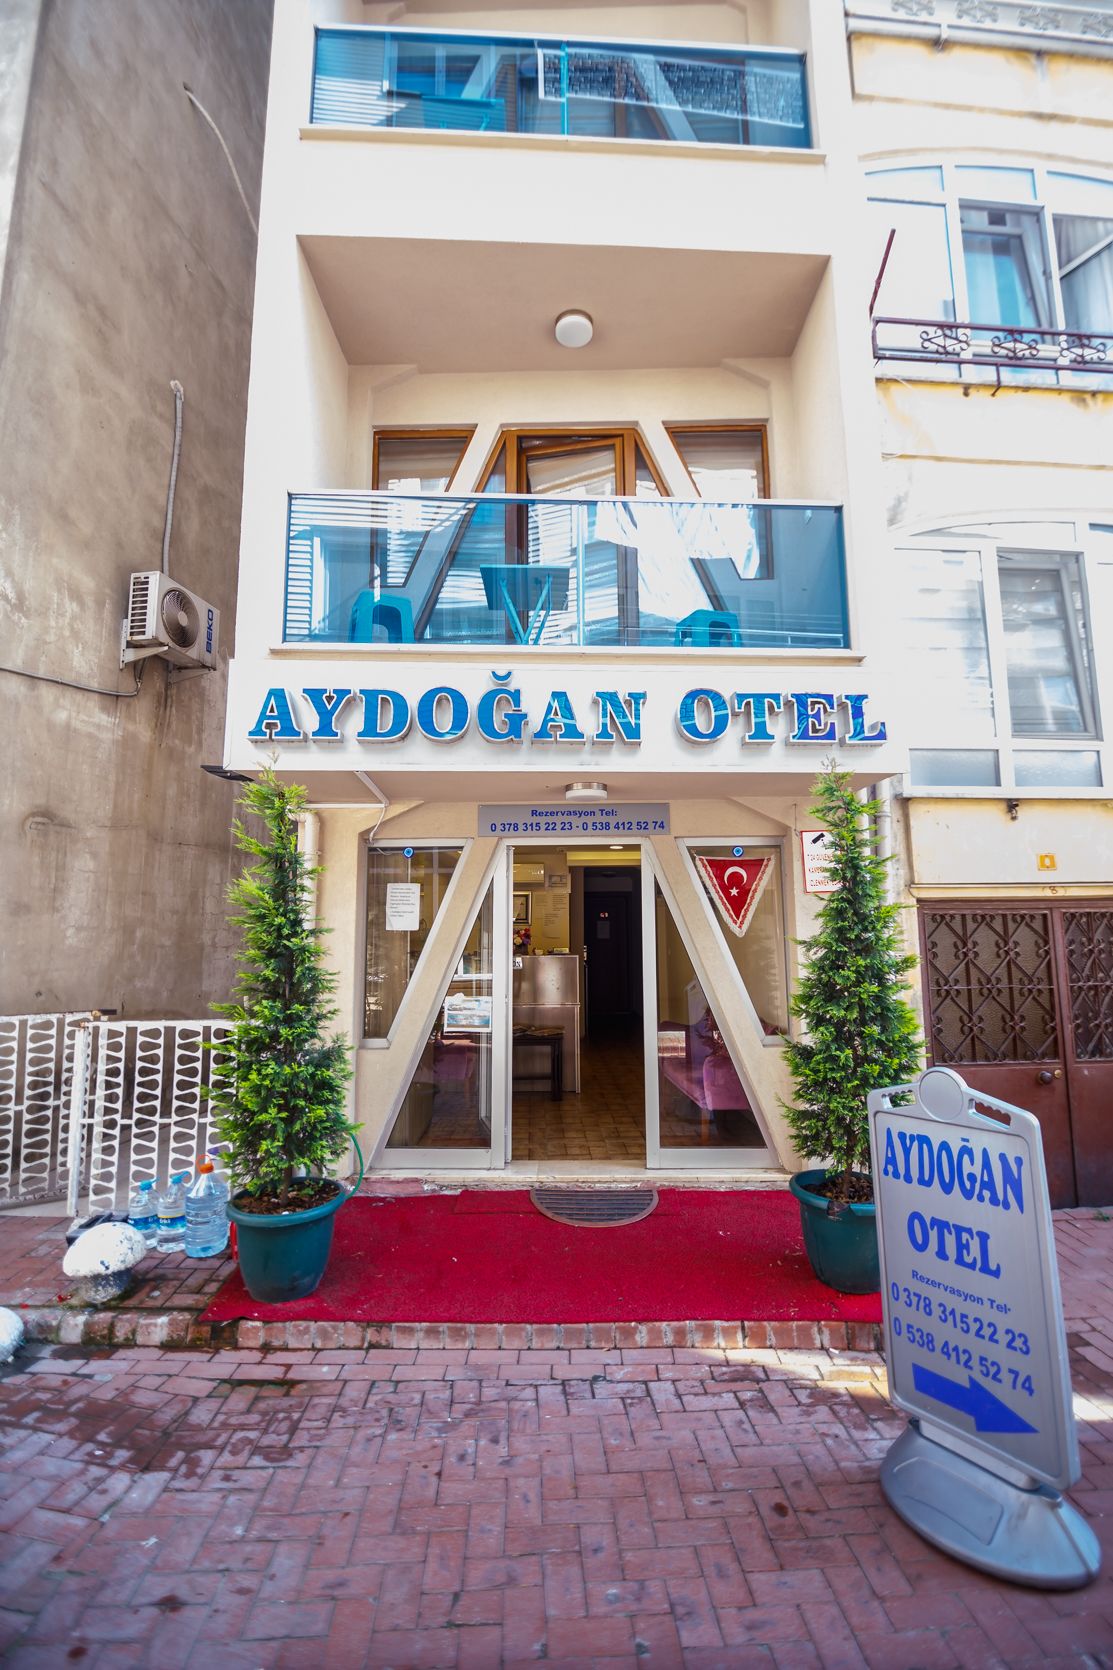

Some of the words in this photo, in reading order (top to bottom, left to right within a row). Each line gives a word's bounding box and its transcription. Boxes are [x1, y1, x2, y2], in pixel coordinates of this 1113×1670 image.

[205, 608, 214, 655] BEKO
[248, 670, 648, 744] AYDOĞAN
[676, 688, 888, 747] OTEL
[490, 823, 497, 832] 0
[500, 822, 519, 832] 378
[522, 822, 541, 832] 315
[544, 821, 557, 831] 22
[560, 821, 573, 831] 23
[582, 821, 588, 831] 0
[591, 821, 611, 831] 538
[613, 821, 633, 831] 412
[636, 821, 649, 830] 52
[652, 820, 665, 830] 74
[531, 809, 596, 818] Rezervasyon
[598, 808, 618, 817] Tel:
[883, 1127, 1024, 1215] AYDOĞAN
[907, 1211, 1002, 1279] OTEL
[891, 1281, 900, 1302] 0
[902, 1287, 933, 1317] 378
[1004, 1328, 1031, 1356] 23
[911, 1269, 984, 1306] Rezervasyon
[893, 1316, 902, 1336] 0
[906, 1323, 936, 1353] 538
[941, 1340, 974, 1371] 412
[979, 1355, 1003, 1384] 52
[1007, 1367, 1035, 1397] 74
